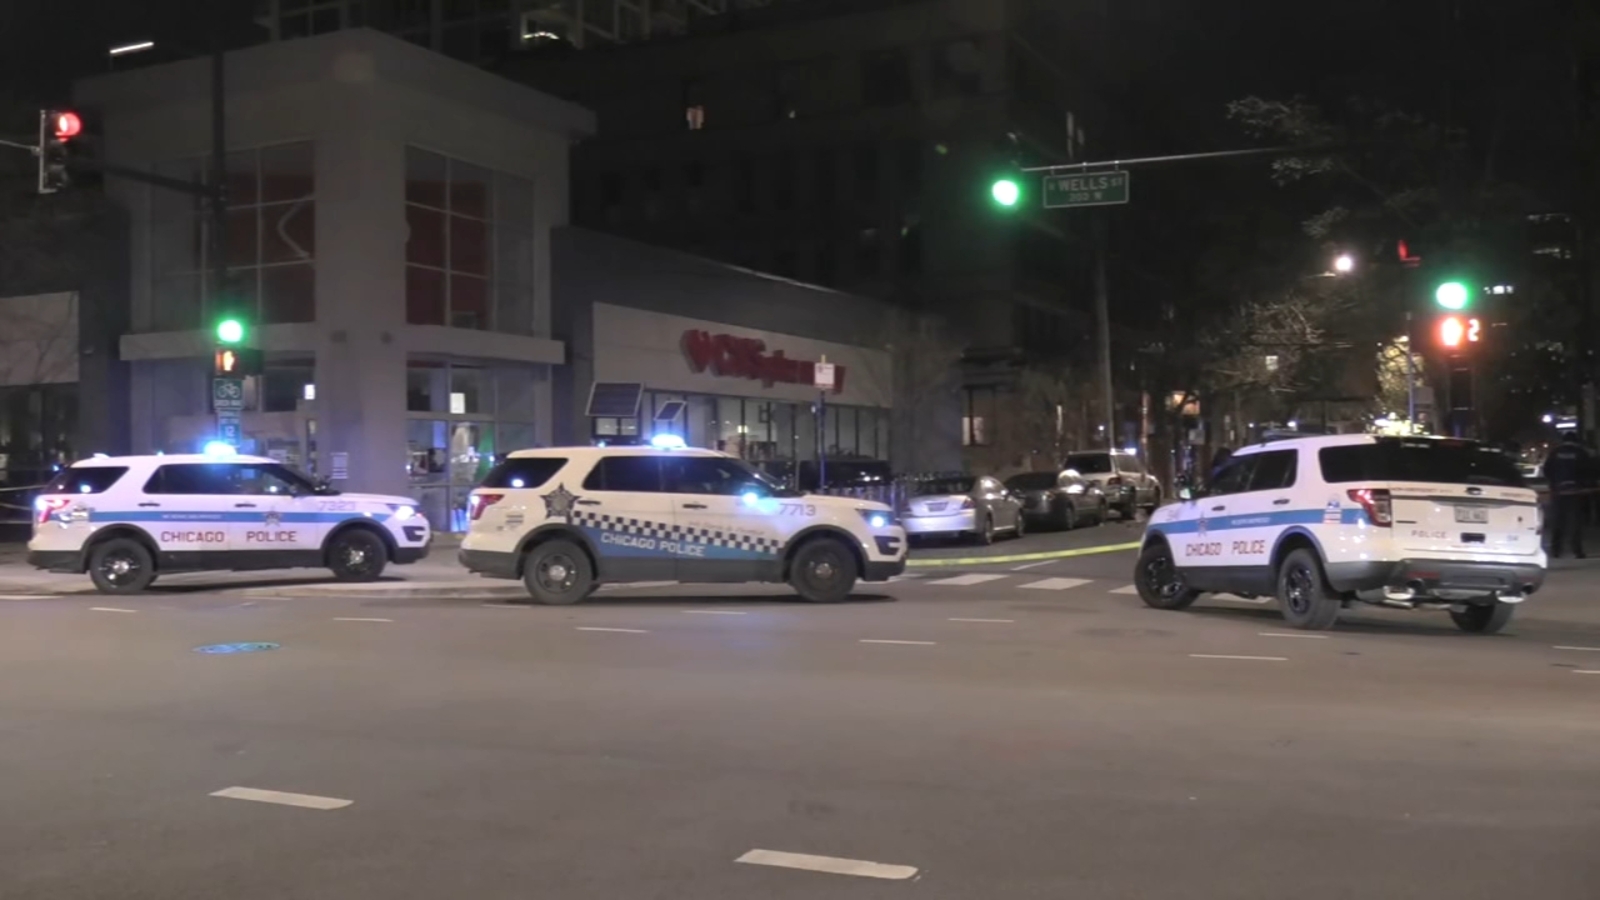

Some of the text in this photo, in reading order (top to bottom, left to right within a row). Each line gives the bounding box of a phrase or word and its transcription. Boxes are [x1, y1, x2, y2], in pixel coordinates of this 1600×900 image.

[1059, 177, 1108, 191] WELLS
[779, 503, 816, 516] 7713
[160, 530, 297, 543] CHICAGO POLICE
[1411, 529, 1447, 540] POLICE
[600, 532, 706, 557] CHICAGO POLICE
[1185, 540, 1265, 557] CHICAGO POLICE
